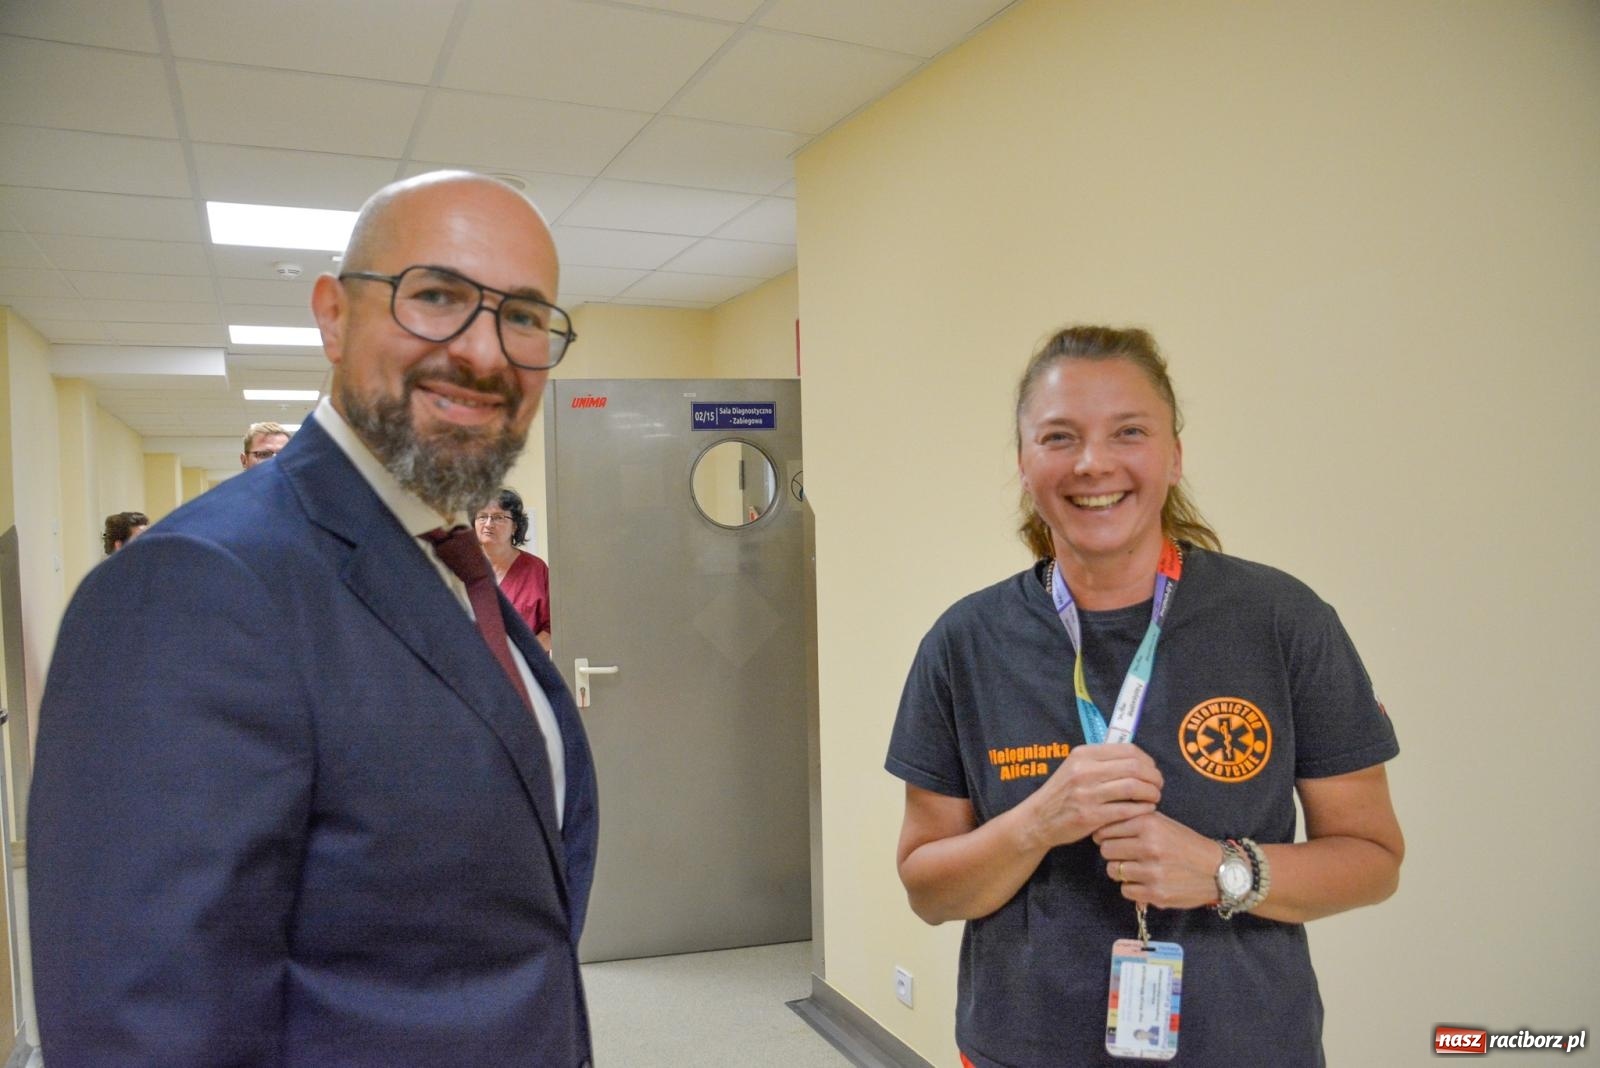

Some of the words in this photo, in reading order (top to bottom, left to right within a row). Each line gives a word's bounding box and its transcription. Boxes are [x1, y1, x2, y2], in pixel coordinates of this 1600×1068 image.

[694, 410, 715, 423] 02/15
[719, 407, 731, 415] Sala
[732, 407, 772, 416] Diagnostyczno
[733, 417, 763, 426] Zabiegowa
[1187, 702, 1263, 730] RATOWNICTWO
[1000, 761, 1049, 781] Alicja
[1195, 755, 1260, 777] MEDYCZNE
